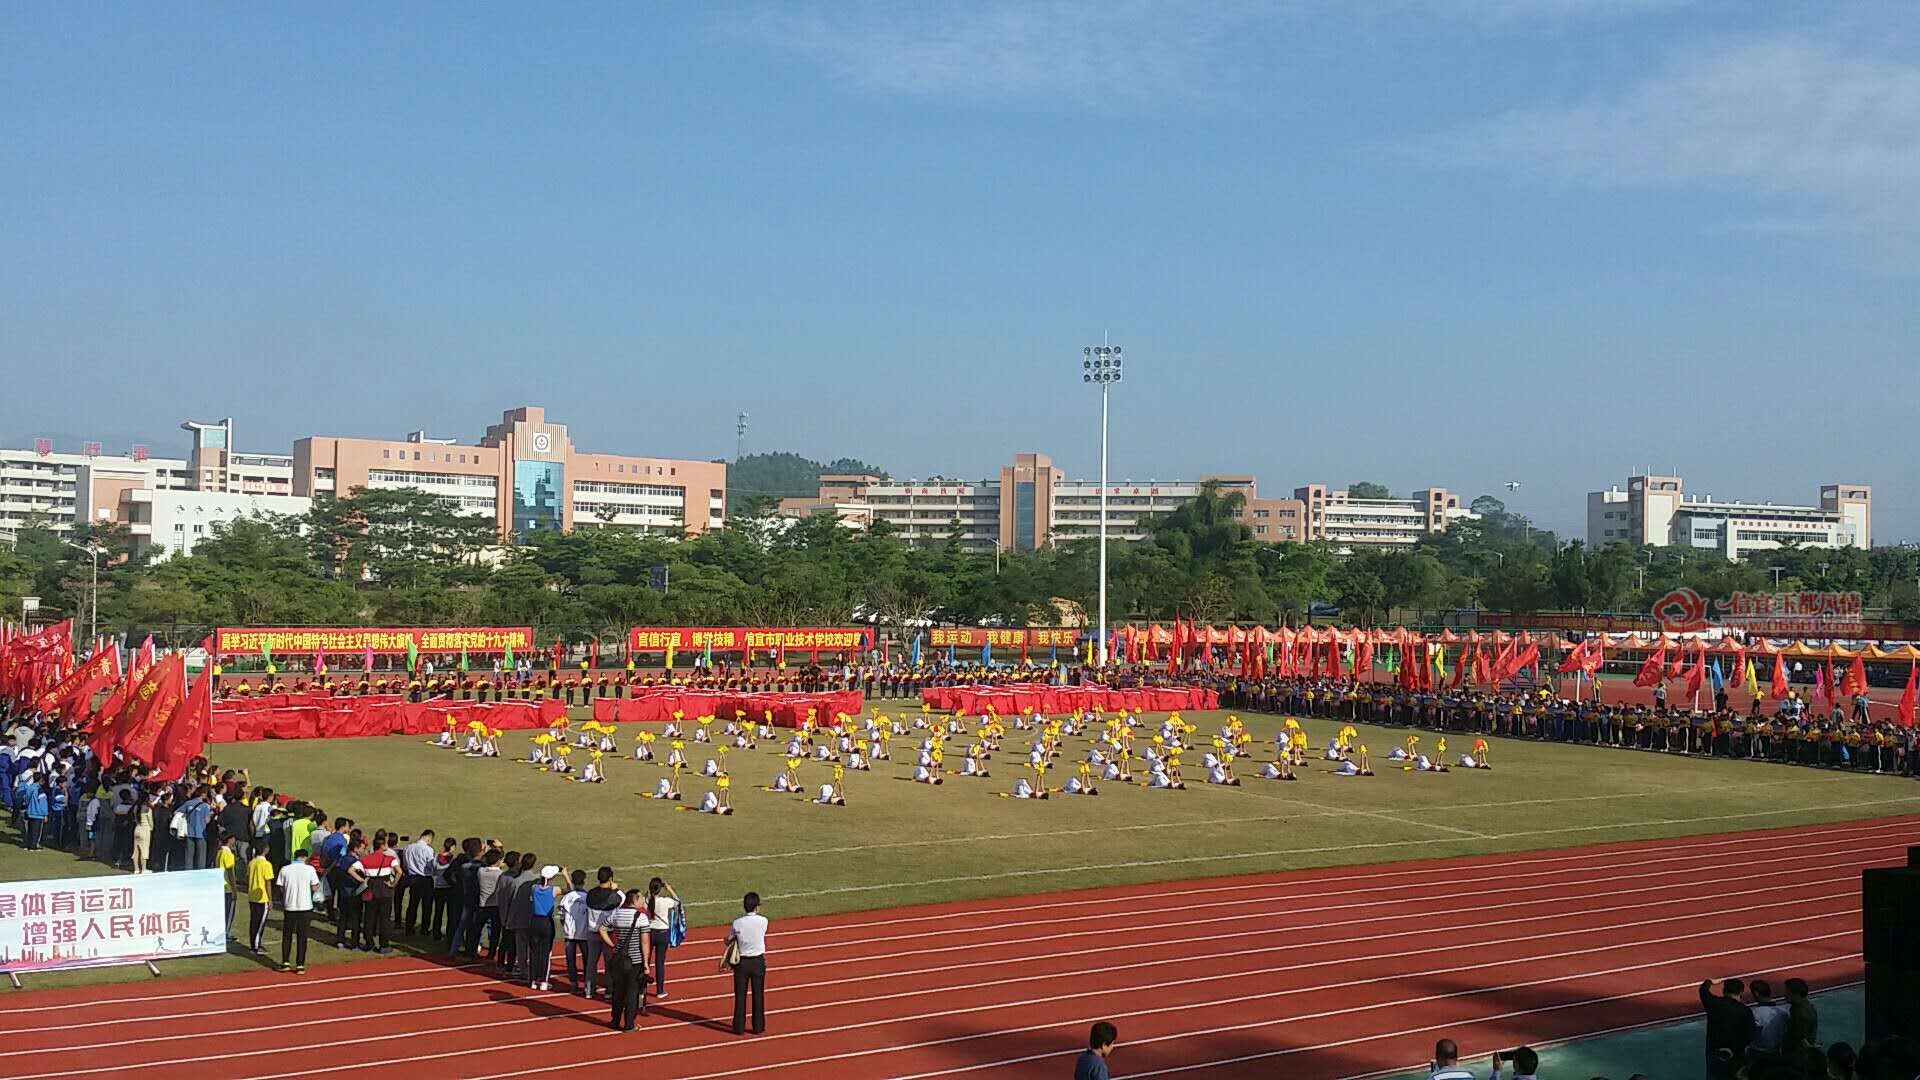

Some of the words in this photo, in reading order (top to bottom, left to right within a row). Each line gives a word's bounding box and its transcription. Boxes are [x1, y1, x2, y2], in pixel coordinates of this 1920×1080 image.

[22, 910, 191, 946] 增强人民体质
